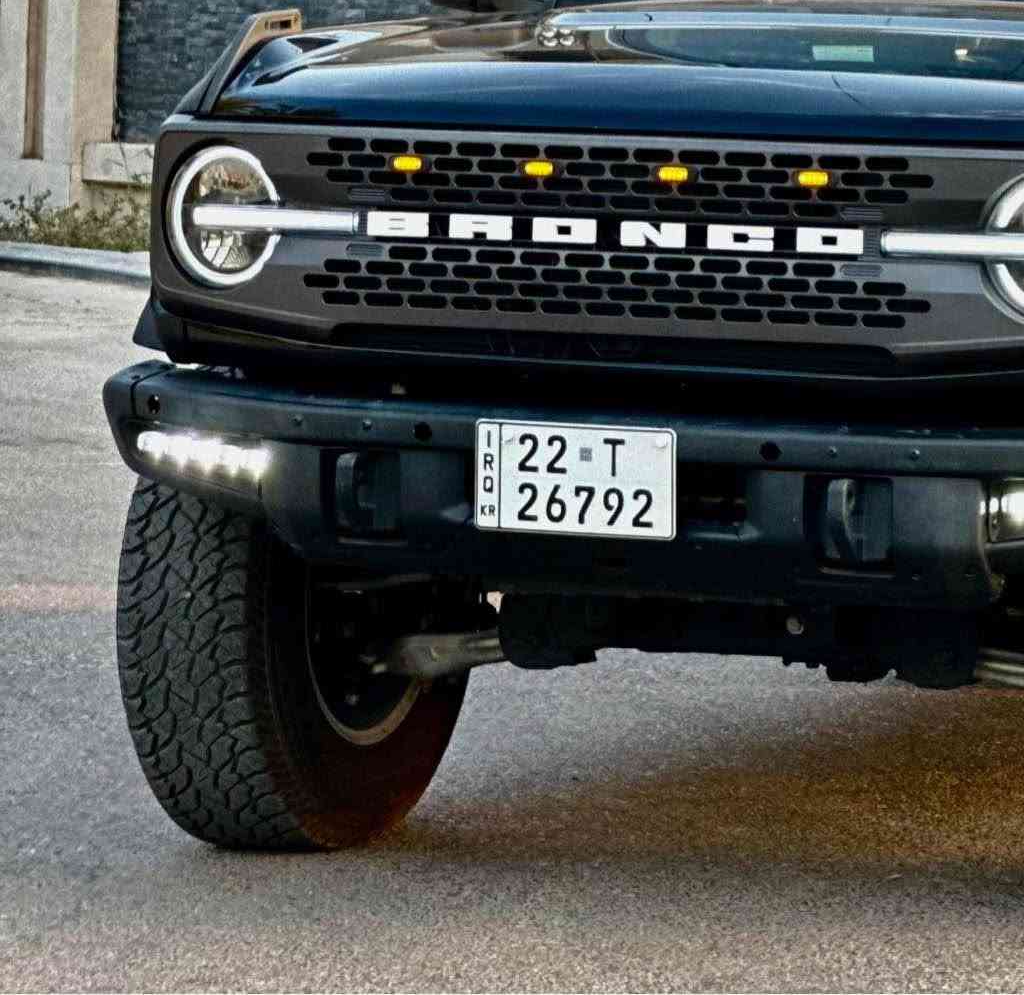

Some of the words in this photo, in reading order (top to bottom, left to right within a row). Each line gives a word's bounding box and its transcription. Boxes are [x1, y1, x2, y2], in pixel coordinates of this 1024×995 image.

[366, 210, 865, 256] BRONCO
[482, 430, 495, 494] IRQ
[517, 433, 568, 475] 22
[602, 438, 626, 478] T
[479, 504, 496, 517] KR
[517, 482, 654, 529] 26792
